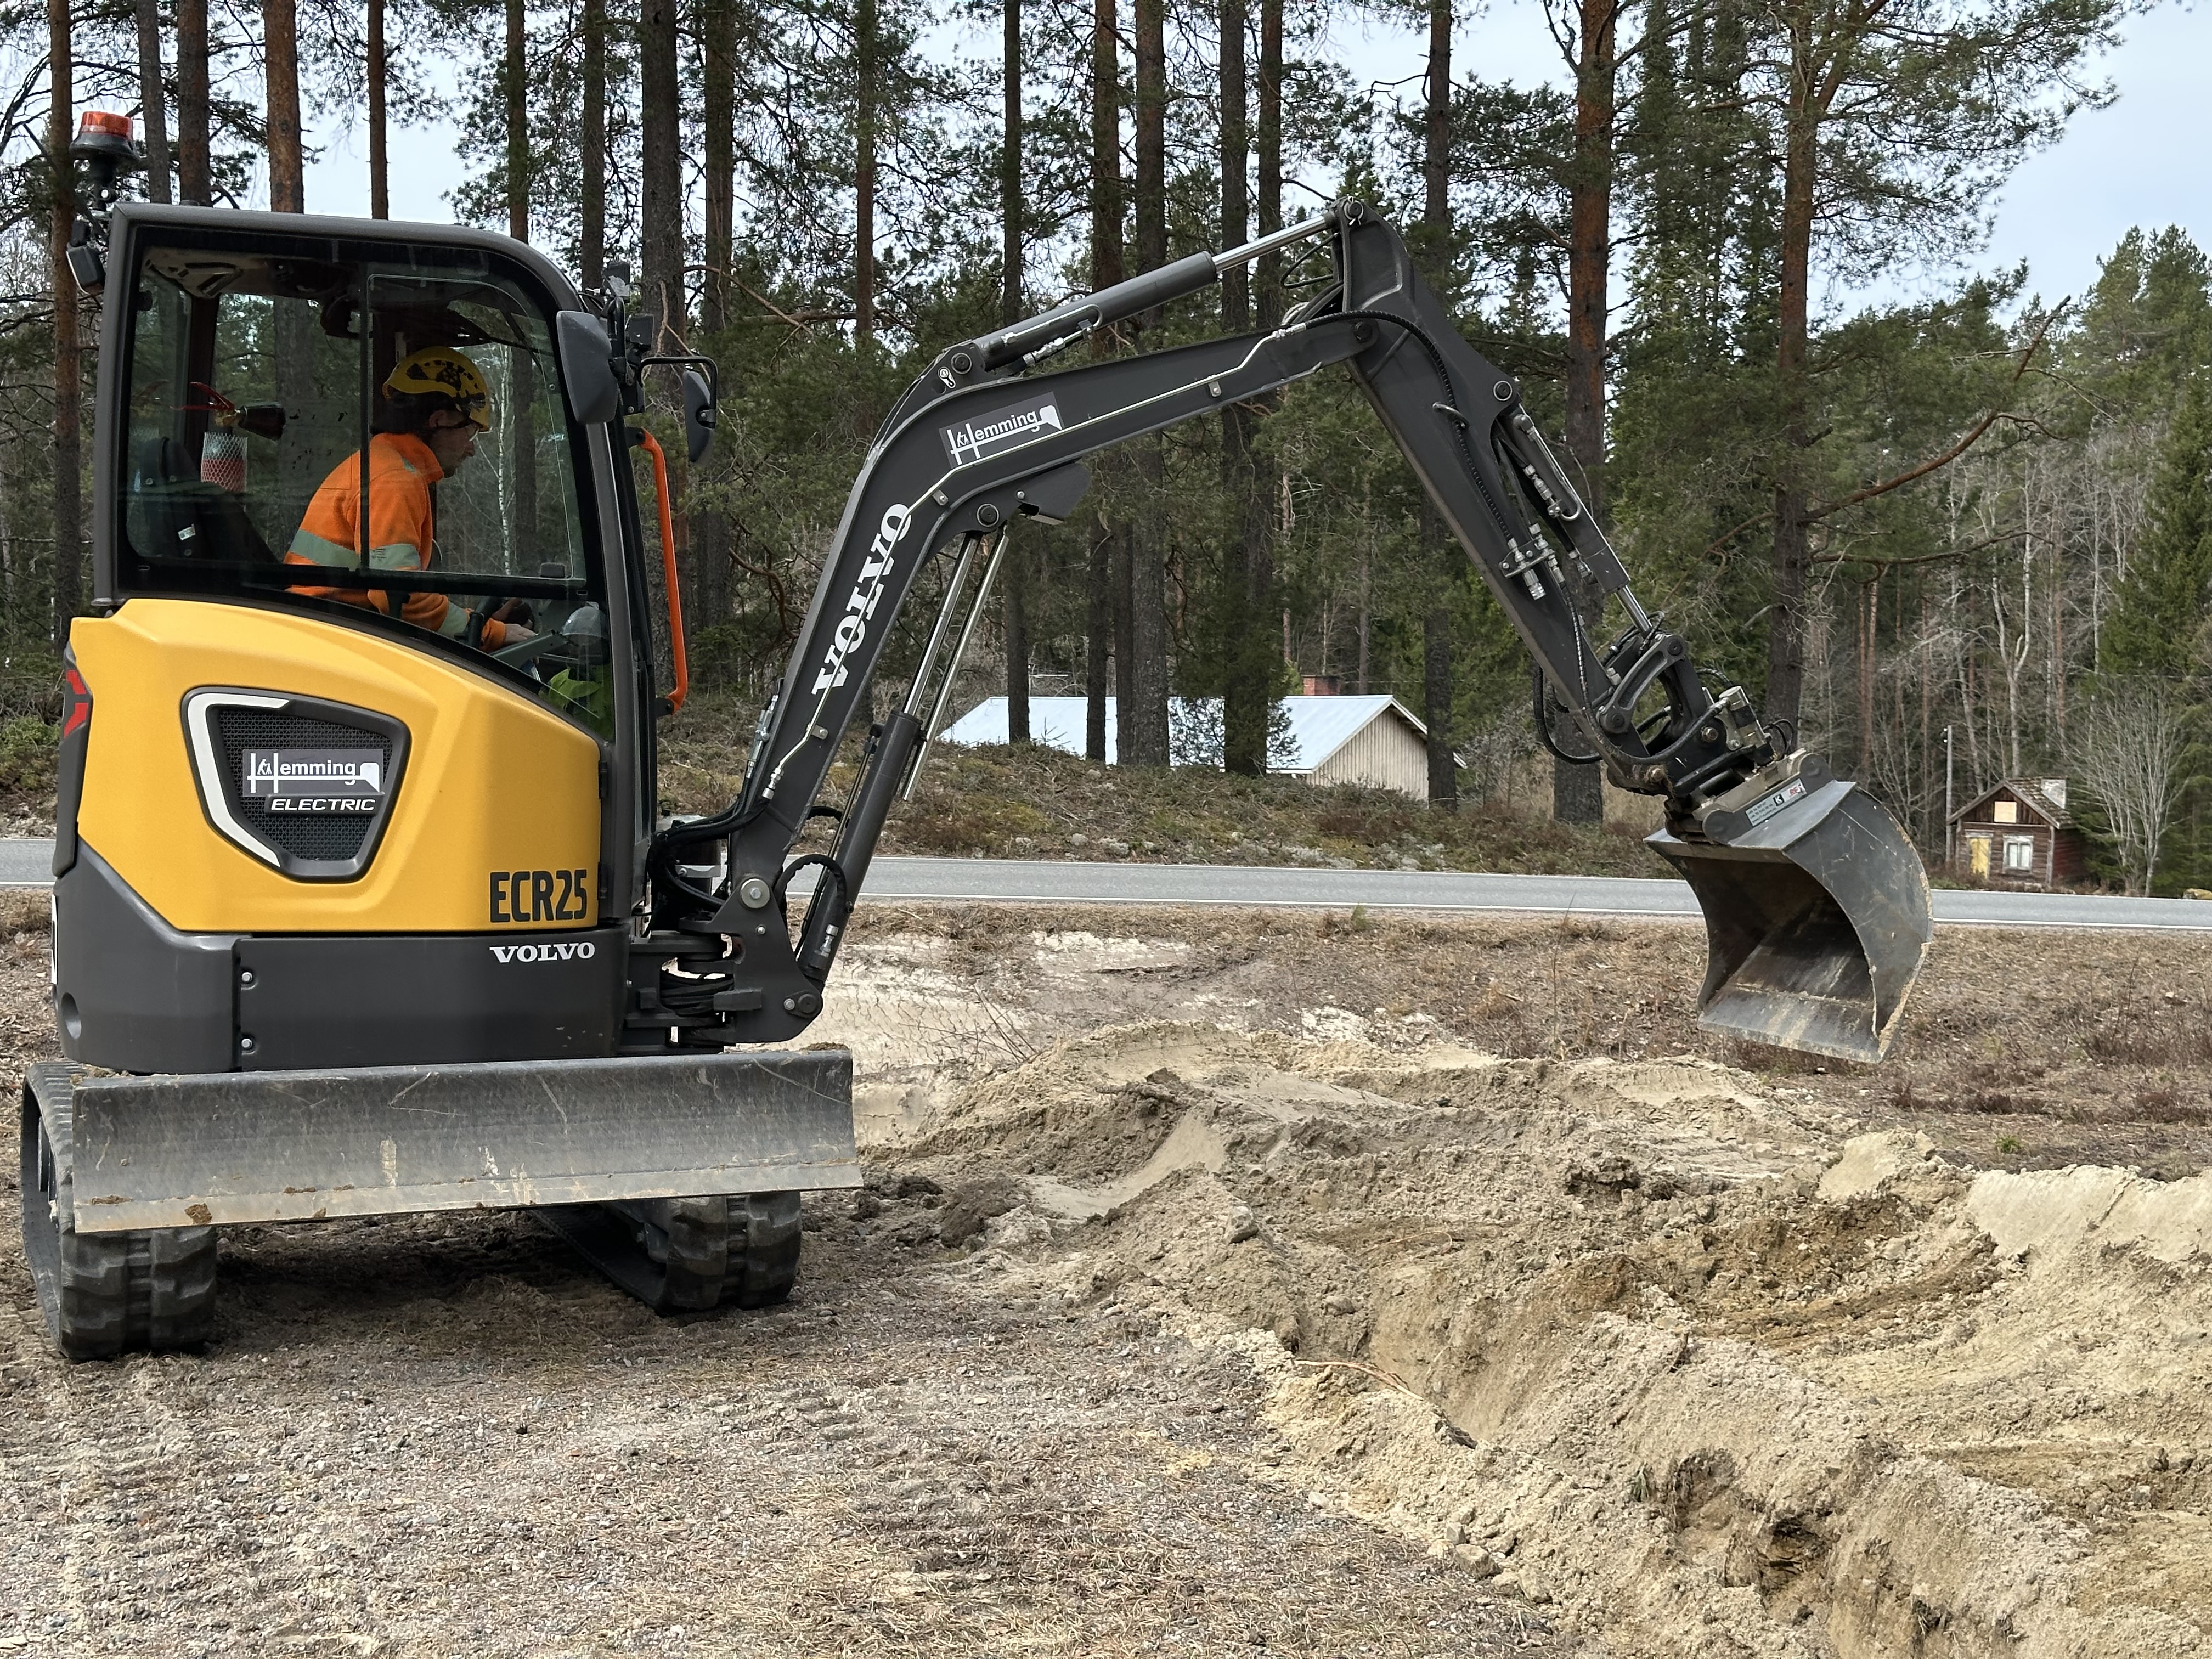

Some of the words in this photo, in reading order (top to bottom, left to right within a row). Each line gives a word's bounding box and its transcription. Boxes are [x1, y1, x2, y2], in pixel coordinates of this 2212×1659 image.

[811, 504, 912, 695] VOLVO
[271, 799, 376, 811] ELECTRIC
[490, 869, 588, 923] ECR25
[489, 942, 595, 963] VOLVO
